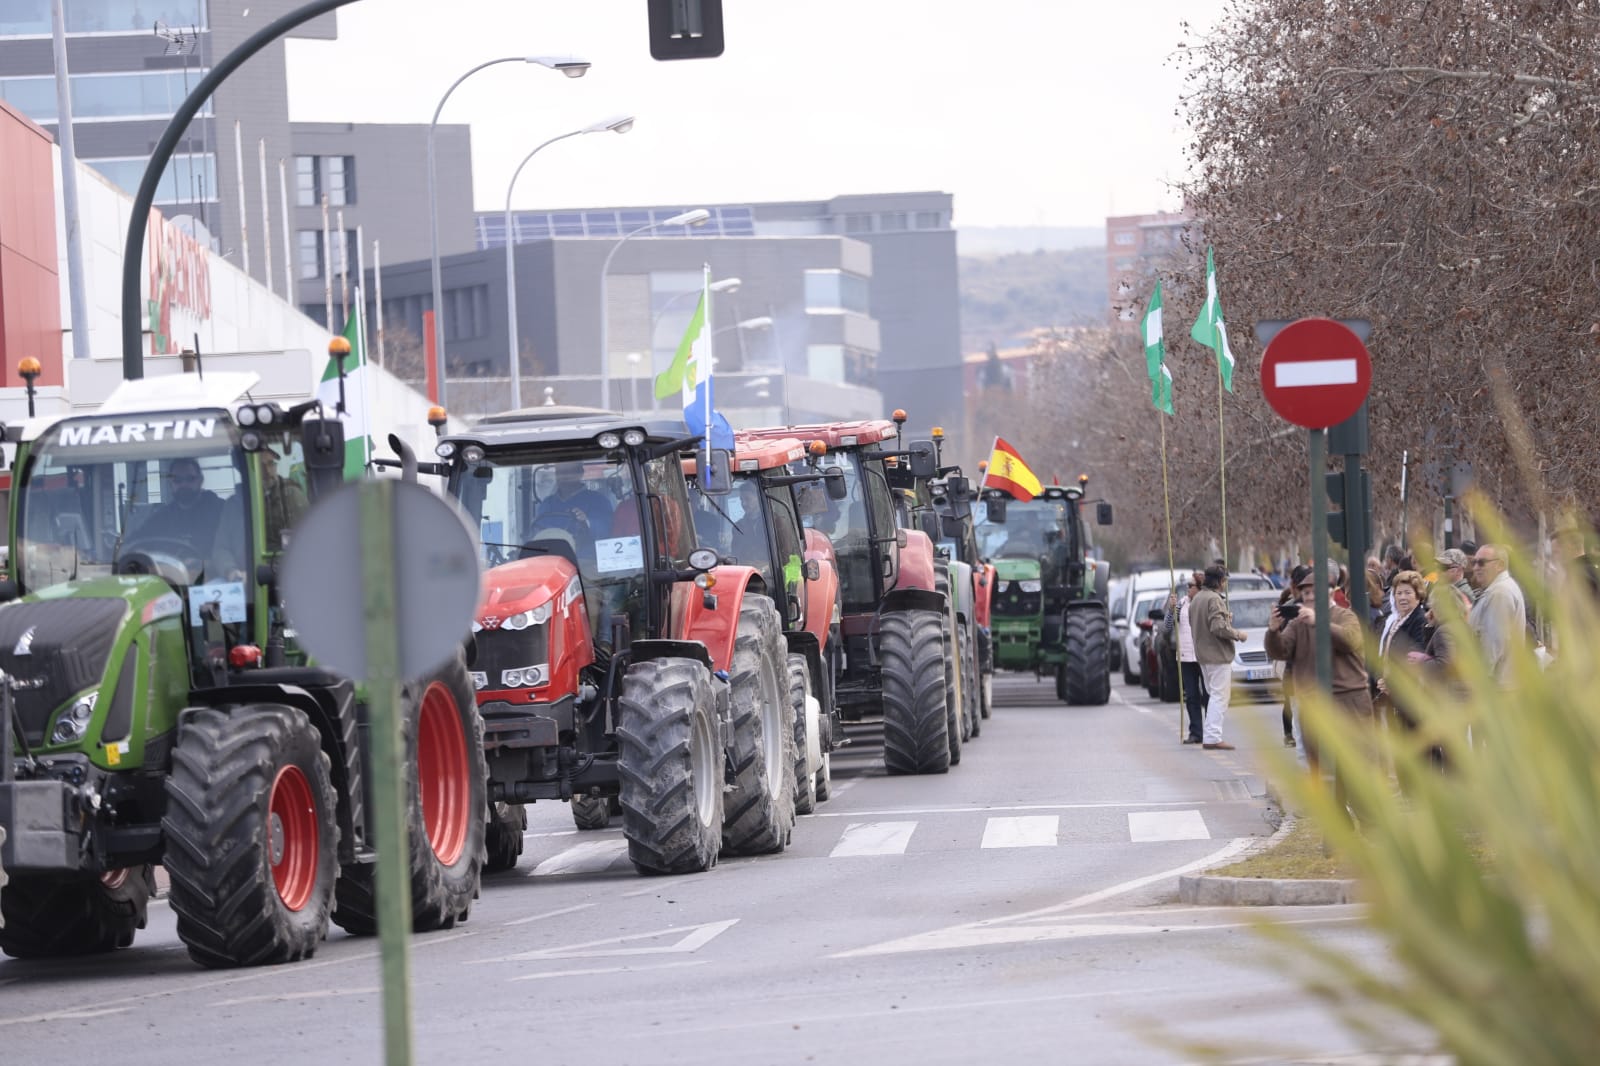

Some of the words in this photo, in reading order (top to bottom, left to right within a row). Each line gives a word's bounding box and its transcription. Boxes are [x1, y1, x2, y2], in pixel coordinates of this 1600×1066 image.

[58, 418, 216, 447] MARTIN
[614, 541, 624, 554] 2
[212, 589, 223, 603] 2
